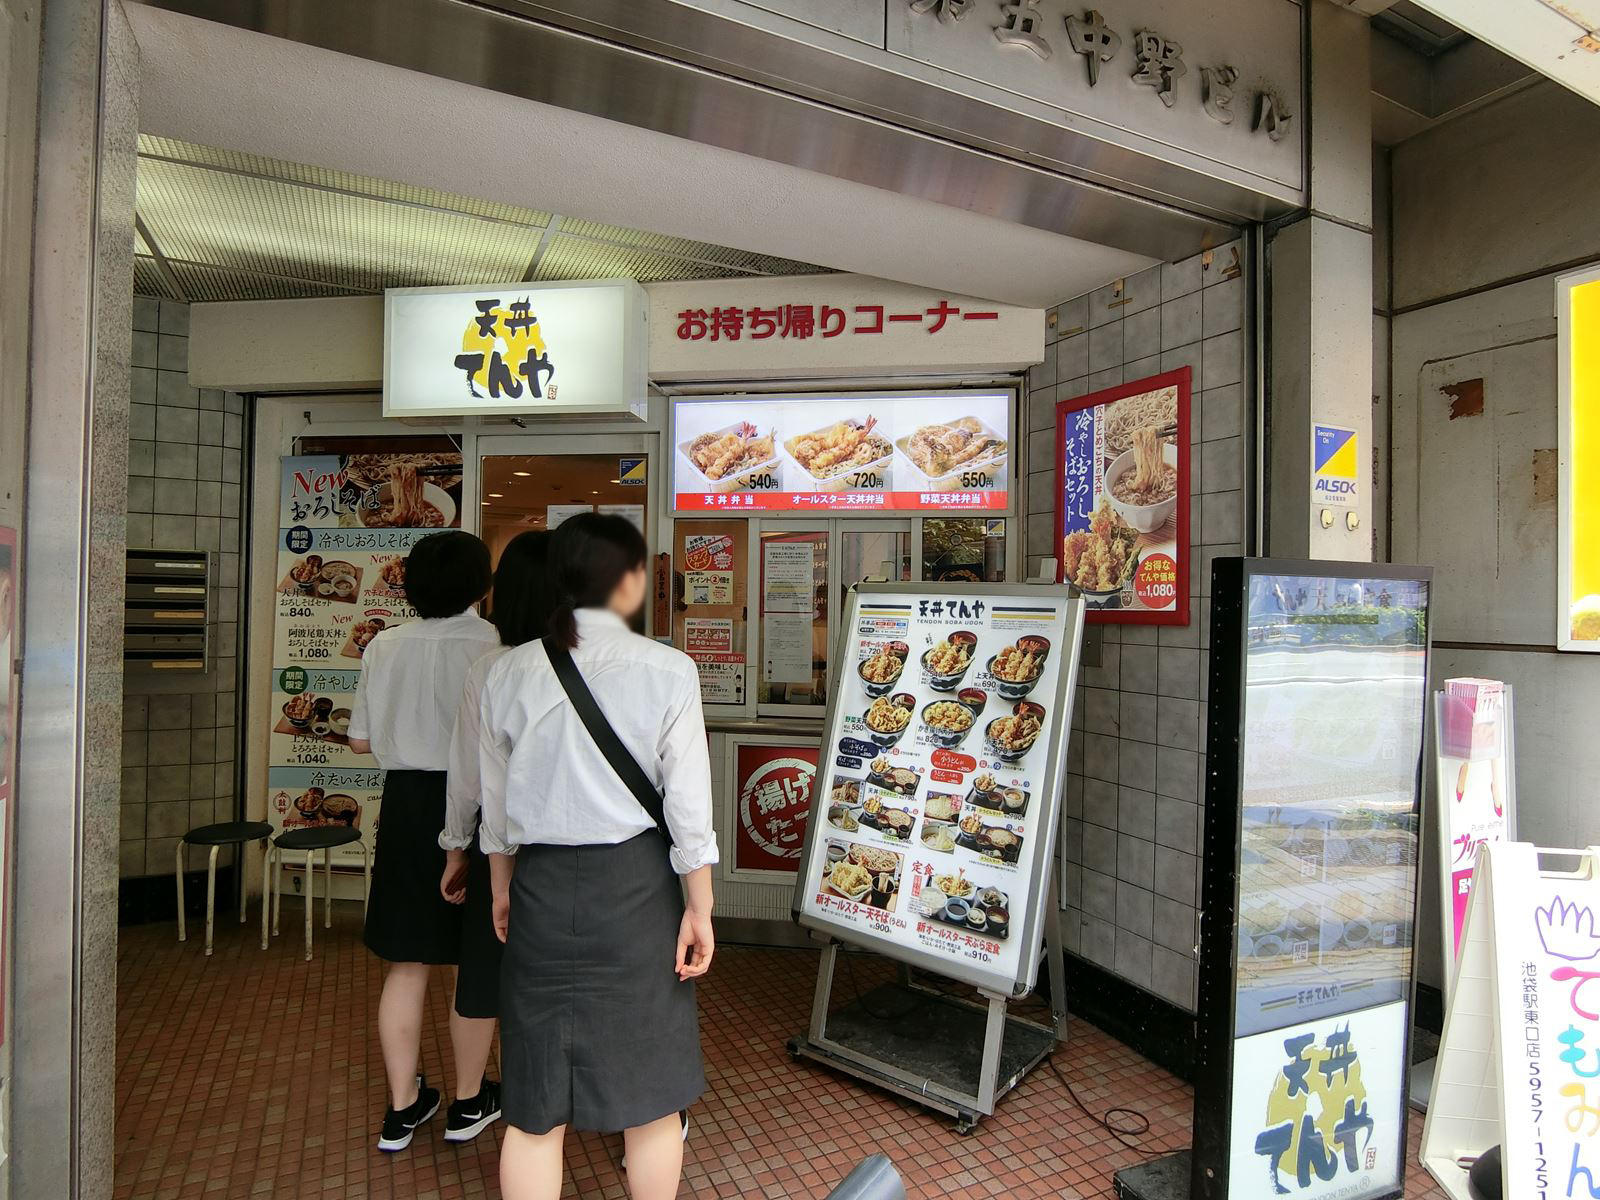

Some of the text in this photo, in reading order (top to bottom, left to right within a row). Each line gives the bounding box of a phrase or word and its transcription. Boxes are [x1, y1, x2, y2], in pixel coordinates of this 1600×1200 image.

[475, 296, 538, 338] 天丼
[676, 300, 998, 341] お持ち帰りコーナー
[454, 348, 555, 399] てんや
[1317, 430, 1335, 438] Security
[291, 469, 349, 498] New
[1065, 438, 1078, 522] そばセット
[1315, 479, 1356, 494] ALSOK
[291, 485, 382, 522] おろしそば
[704, 495, 754, 505] 天丼弁当
[792, 494, 884, 505] オールスター天丼弁当
[920, 493, 981, 505] 野菜天丼弁当
[291, 530, 308, 539] 期間
[291, 540, 308, 549] 限定
[370, 554, 393, 565] New
[1144, 560, 1171, 571] お得な
[1139, 572, 1175, 582] てんや価格
[331, 614, 354, 625] New
[286, 680, 303, 690] 限定
[754, 772, 811, 815] 揚げ
[912, 860, 935, 876] 定食
[916, 922, 1001, 955] 新オールスター天ぷら定食
[1283, 1019, 1358, 1097] 天丼
[1254, 1098, 1375, 1195] てんや
